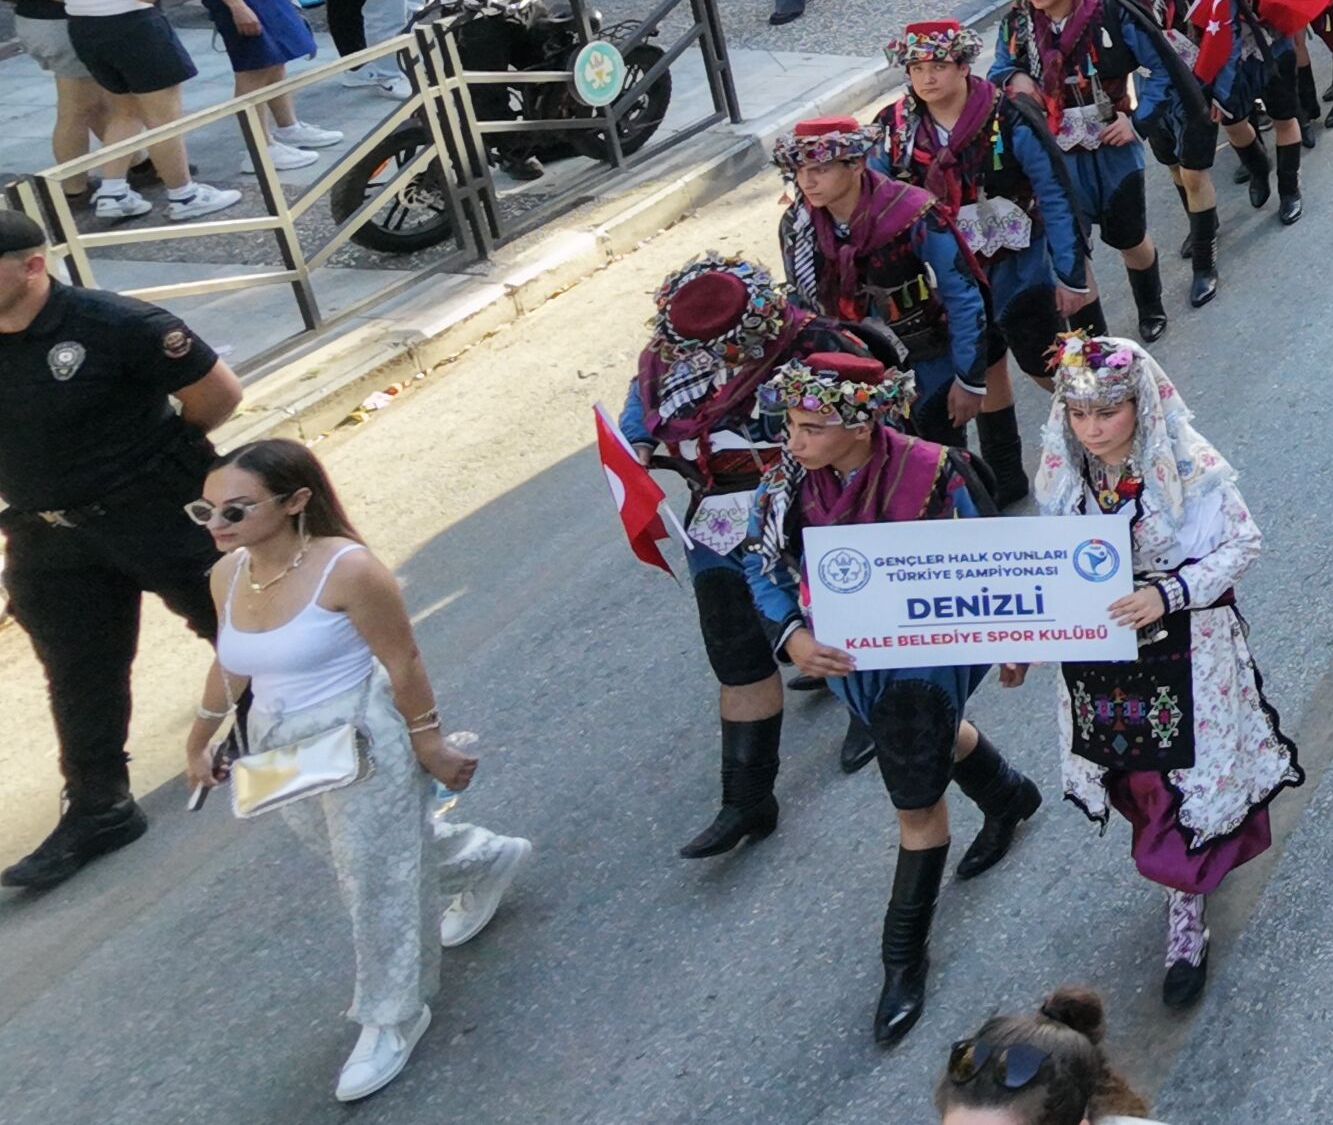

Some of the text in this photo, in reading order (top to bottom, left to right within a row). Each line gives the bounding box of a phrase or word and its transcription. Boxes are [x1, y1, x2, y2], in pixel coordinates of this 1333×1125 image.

[873, 549, 1068, 570] GENÇLER HALK OYUNLARI
[886, 563, 1059, 582] TÜRKİYE ŞAMPİYONASI
[906, 584, 1045, 620] DENİZLİ
[845, 624, 1109, 650] KALE BELEDİYE SPOR KULÜBÜ
